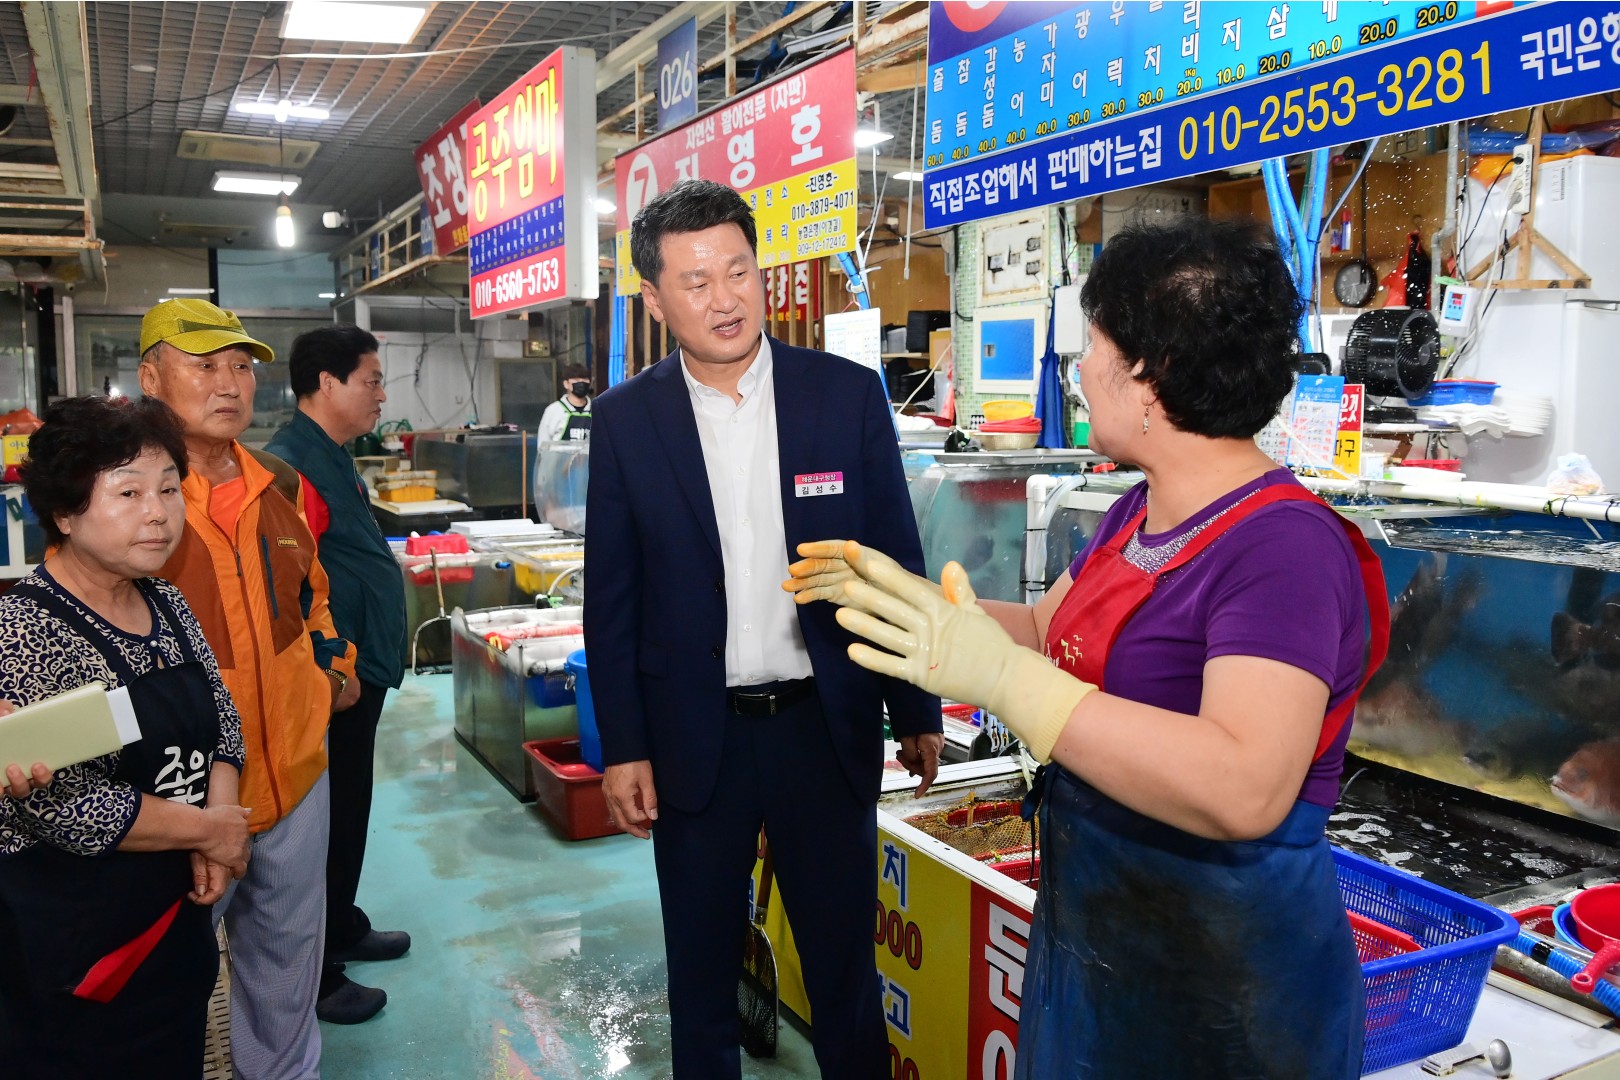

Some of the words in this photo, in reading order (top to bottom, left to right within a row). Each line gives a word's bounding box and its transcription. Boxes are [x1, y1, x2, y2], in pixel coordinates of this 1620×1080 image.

[660, 49, 693, 110] 026
[926, 152, 944, 167] 60.0
[951, 145, 970, 161] 40.0
[977, 137, 997, 153] 40.0
[1005, 128, 1026, 146] 40.0
[1035, 118, 1058, 136] 40.0
[1067, 109, 1091, 128] 30.0
[1101, 99, 1126, 118] 30.0
[1138, 87, 1164, 107] 30.0
[1177, 76, 1202, 96] 20.0
[1216, 63, 1246, 86] 10.0
[1258, 51, 1292, 75] 20.0
[1308, 35, 1343, 60] 10.0
[1360, 18, 1398, 46] 20.0
[1416, 1, 1458, 29] 20.0
[1010, 37, 1027, 118] 농어
[1040, 21, 1058, 108] 가자미
[1073, 8, 1091, 98] 광어
[1106, 1, 1125, 87] 우럭
[685, 116, 716, 149] 자연산
[721, 92, 766, 136] 활어전문
[929, 157, 1038, 216] 직접조업해서
[1047, 124, 1163, 191] 판매하는집
[1178, 40, 1491, 161] 010-2553-3281
[930, 66, 945, 146] 줄돔
[955, 57, 971, 138] 참돔
[981, 46, 998, 130] 감성돔
[421, 122, 468, 229] 초장
[471, 66, 559, 224] 공주엄마
[634, 165, 650, 209] 7
[791, 191, 854, 221] 010-3879-4071
[475, 257, 559, 310] 010-6560-5753
